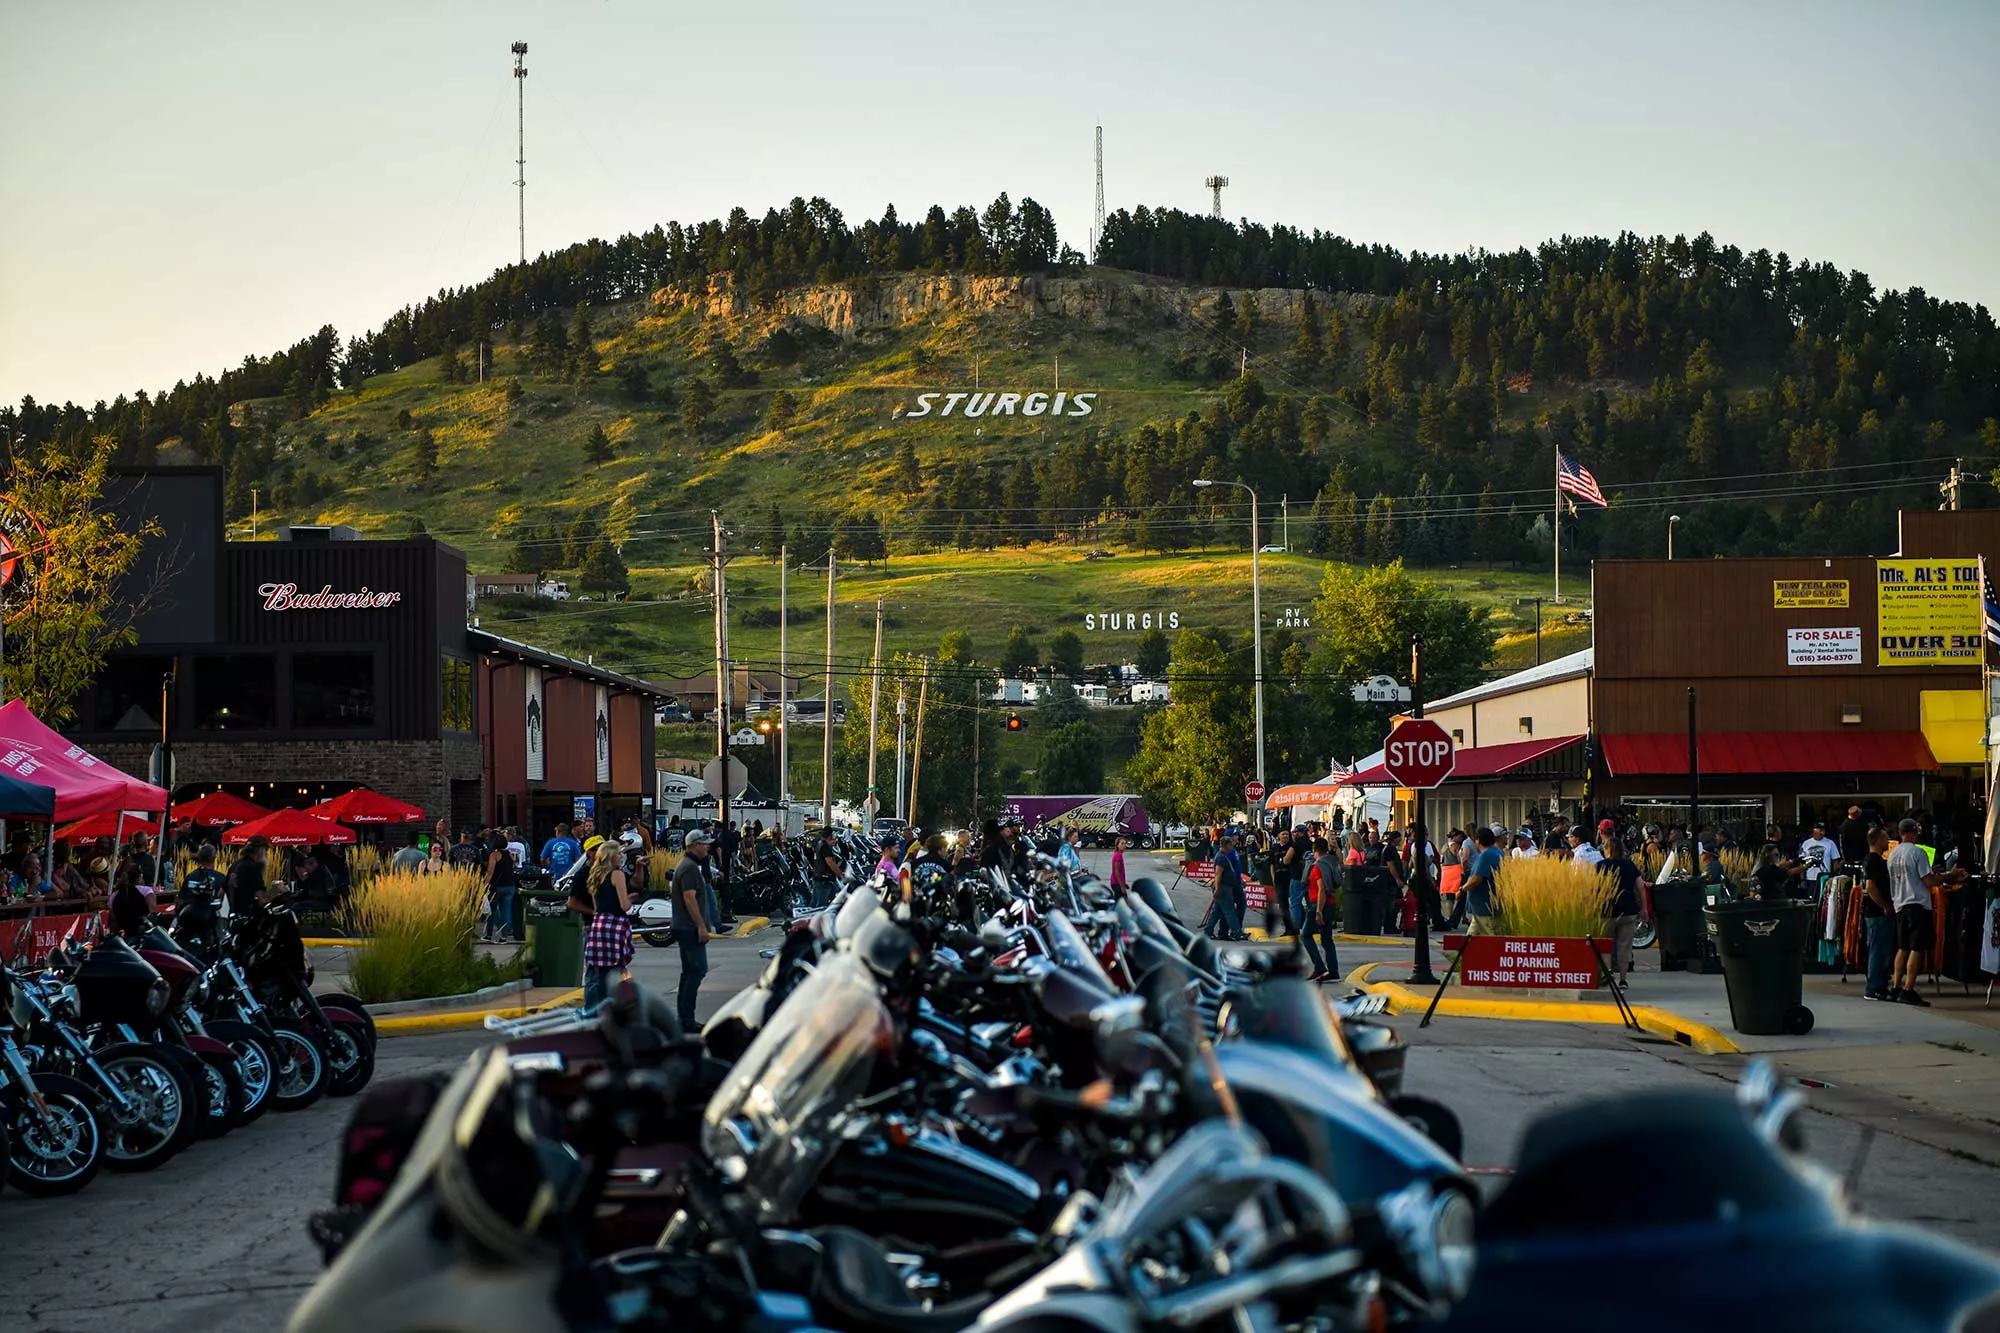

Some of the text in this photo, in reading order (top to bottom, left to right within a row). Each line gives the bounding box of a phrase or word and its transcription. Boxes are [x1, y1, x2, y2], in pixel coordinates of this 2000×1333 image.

[906, 392, 1097, 418] STURGIS
[1914, 567, 1946, 582] AL'S
[258, 583, 400, 611] Budweiser
[1285, 608, 1300, 618] RV
[1085, 612, 1179, 630] STURGIS
[1276, 618, 1311, 627] PARK
[1795, 631, 1853, 640] FOR SALE
[1881, 635, 1981, 648] OVER 30
[1367, 689, 1400, 699] Main St
[1390, 741, 1449, 767] STOP
[664, 785, 688, 793] RC
[1246, 787, 1264, 795] STOP
[353, 814, 388, 822] Budweiser
[1067, 807, 1108, 820] Indian
[270, 835, 307, 843] Budweiser
[1505, 942, 1555, 953] FIRE LANE
[1500, 957, 1560, 968] NO PARKING
[1468, 970, 1592, 984] THIS SIDE OF THE STREET
